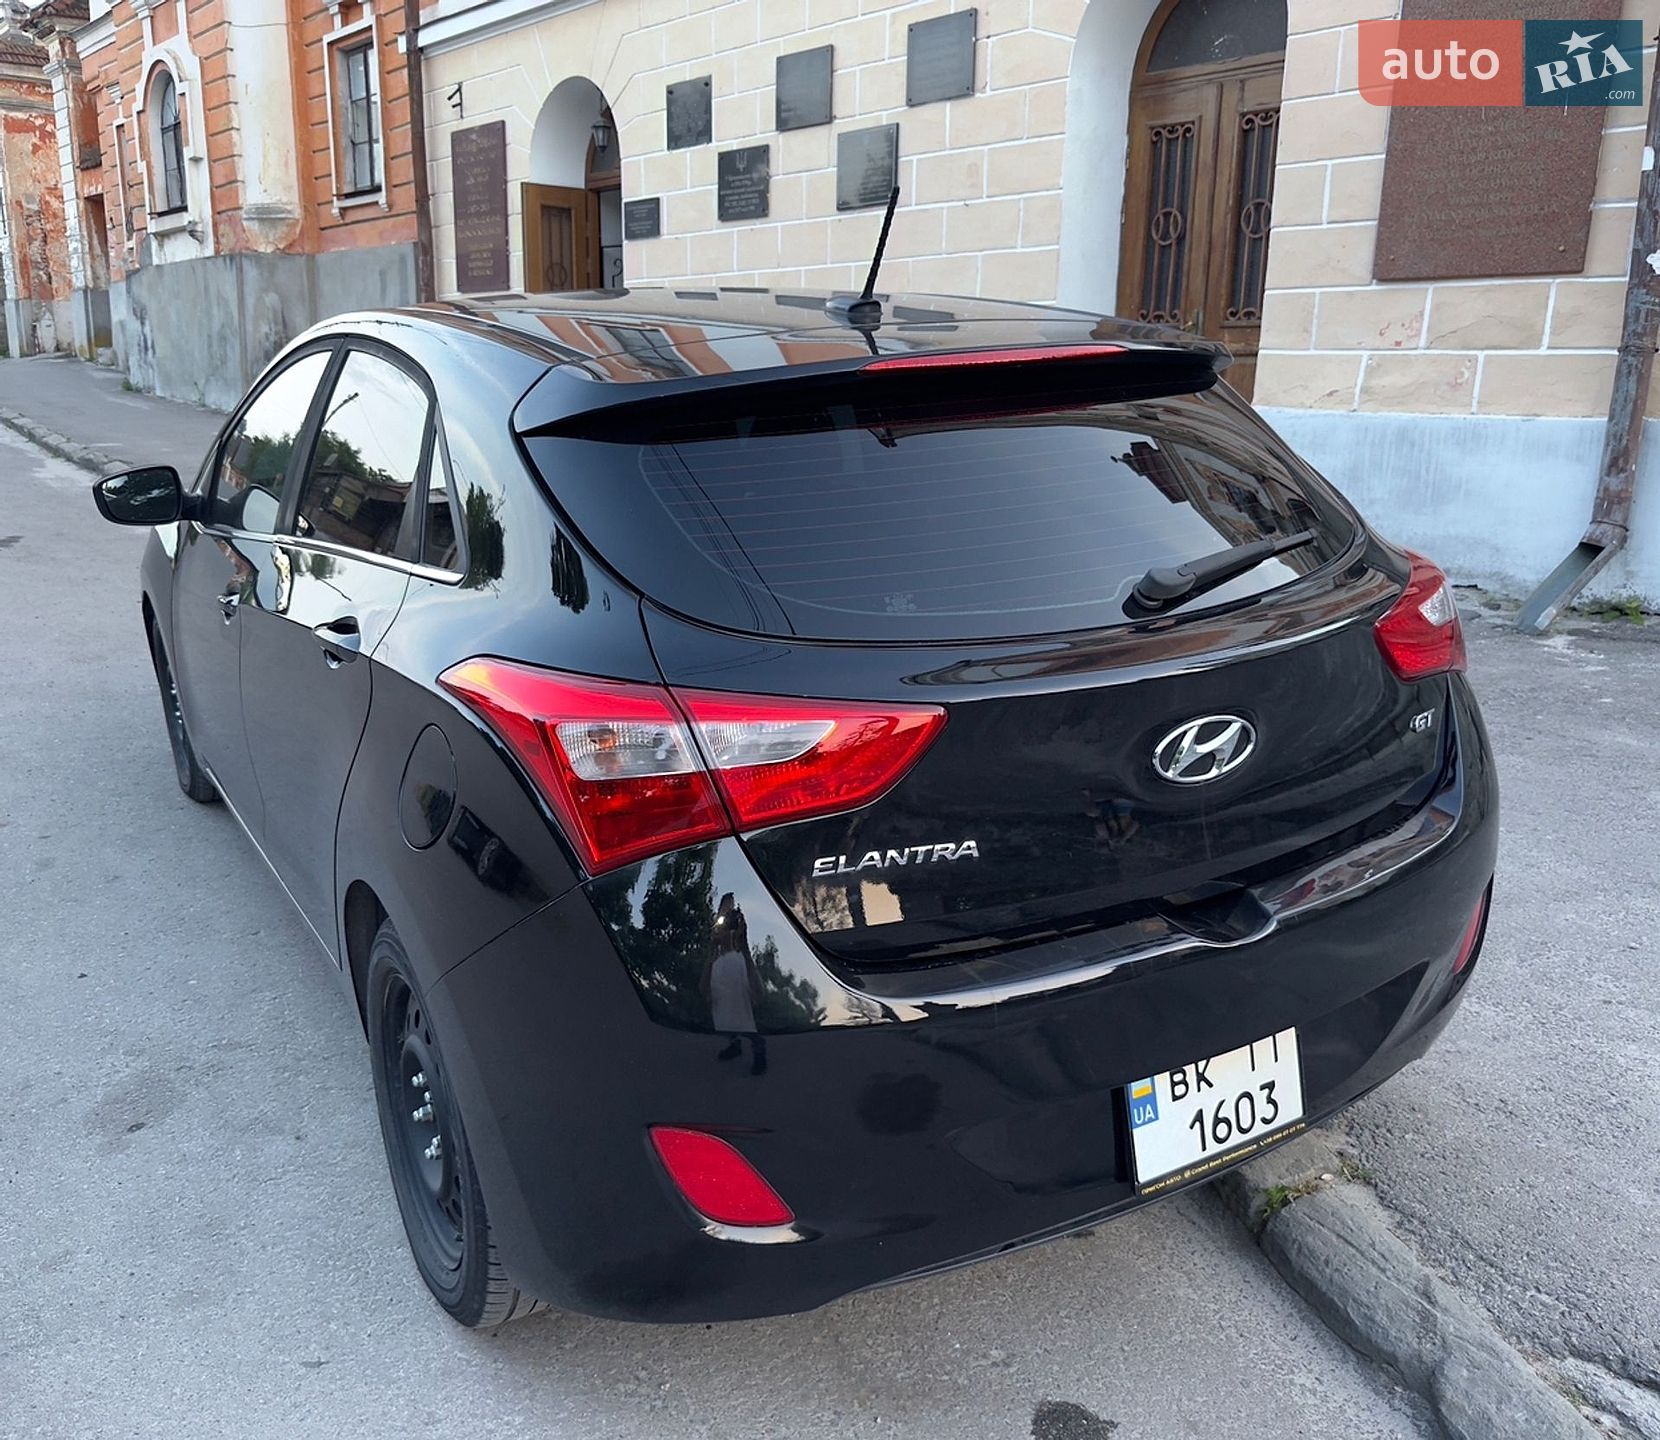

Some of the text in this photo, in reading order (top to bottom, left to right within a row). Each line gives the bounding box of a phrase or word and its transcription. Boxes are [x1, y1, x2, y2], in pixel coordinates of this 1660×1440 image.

[811, 839, 980, 878] ELANTRA
[1169, 1058, 1214, 1102] BK
[1133, 1105, 1156, 1125] UA
[1189, 1079, 1279, 1152] 1603
